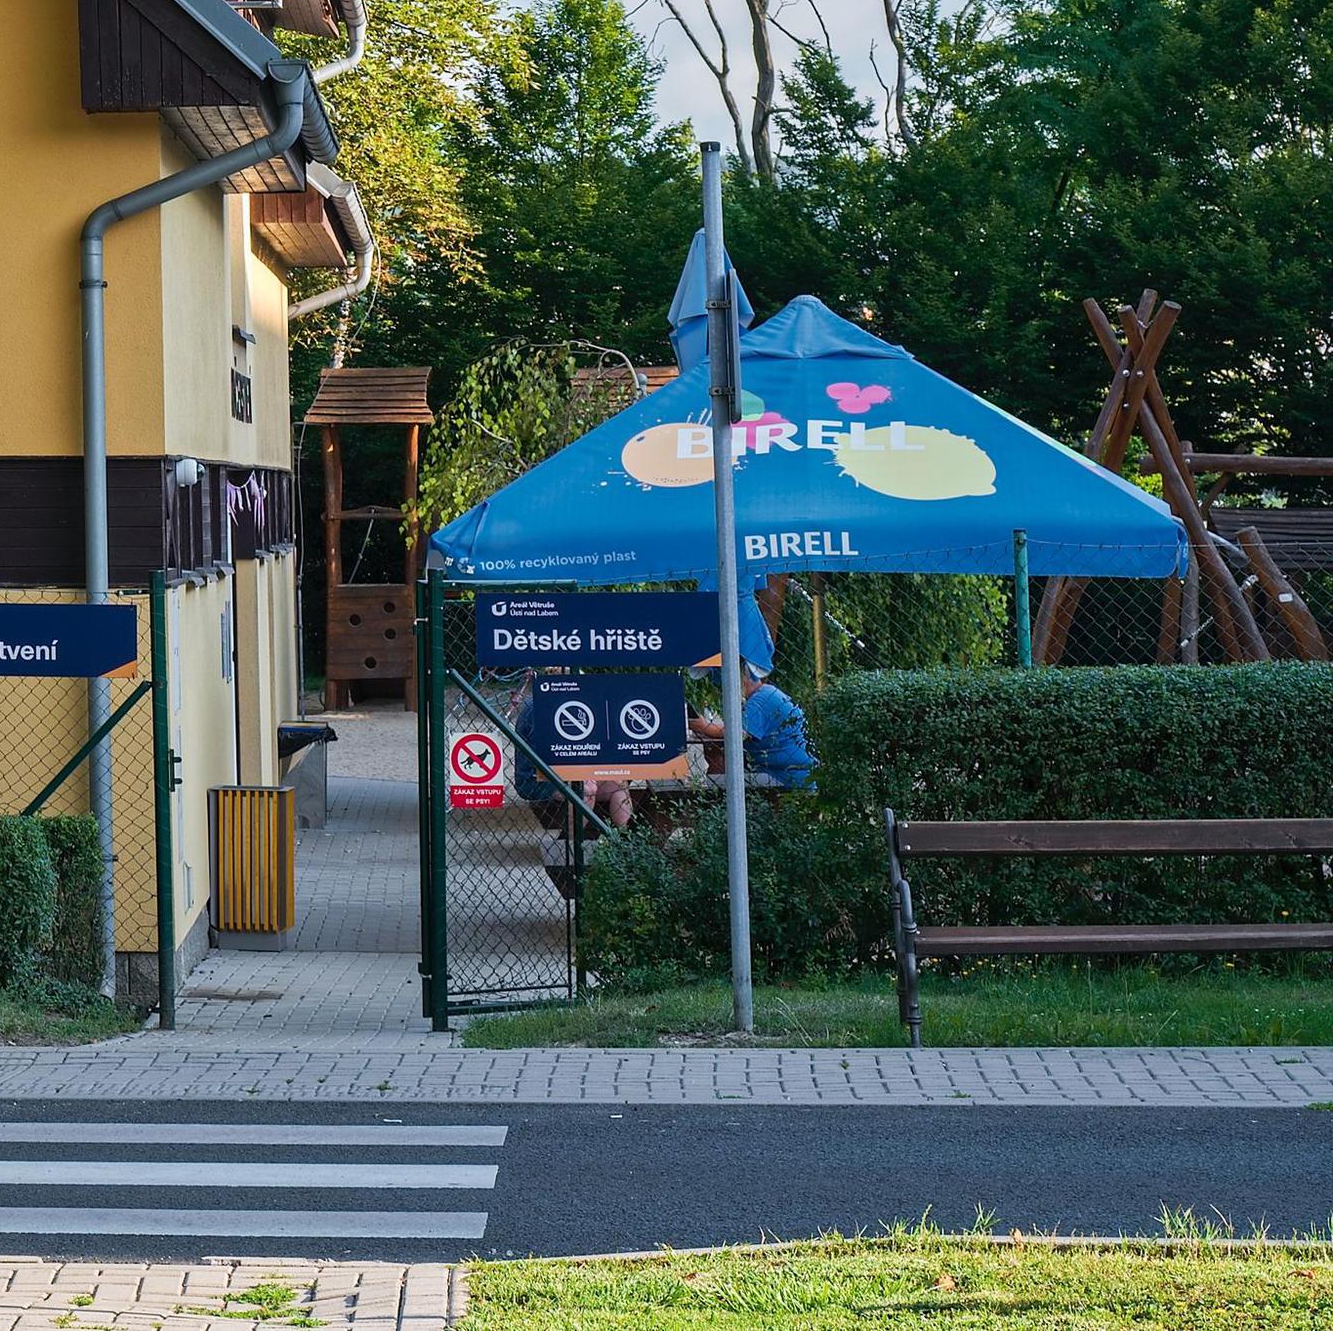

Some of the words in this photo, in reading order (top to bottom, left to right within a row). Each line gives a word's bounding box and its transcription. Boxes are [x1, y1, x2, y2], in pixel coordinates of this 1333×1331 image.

[676, 419, 926, 459] BIRELL
[744, 531, 859, 560] BIRELL
[480, 559, 516, 570] 100%
[520, 552, 599, 569] recyklovaný
[603, 550, 637, 564] plast
[493, 629, 582, 651] Dětské
[589, 628, 663, 651] hřiště
